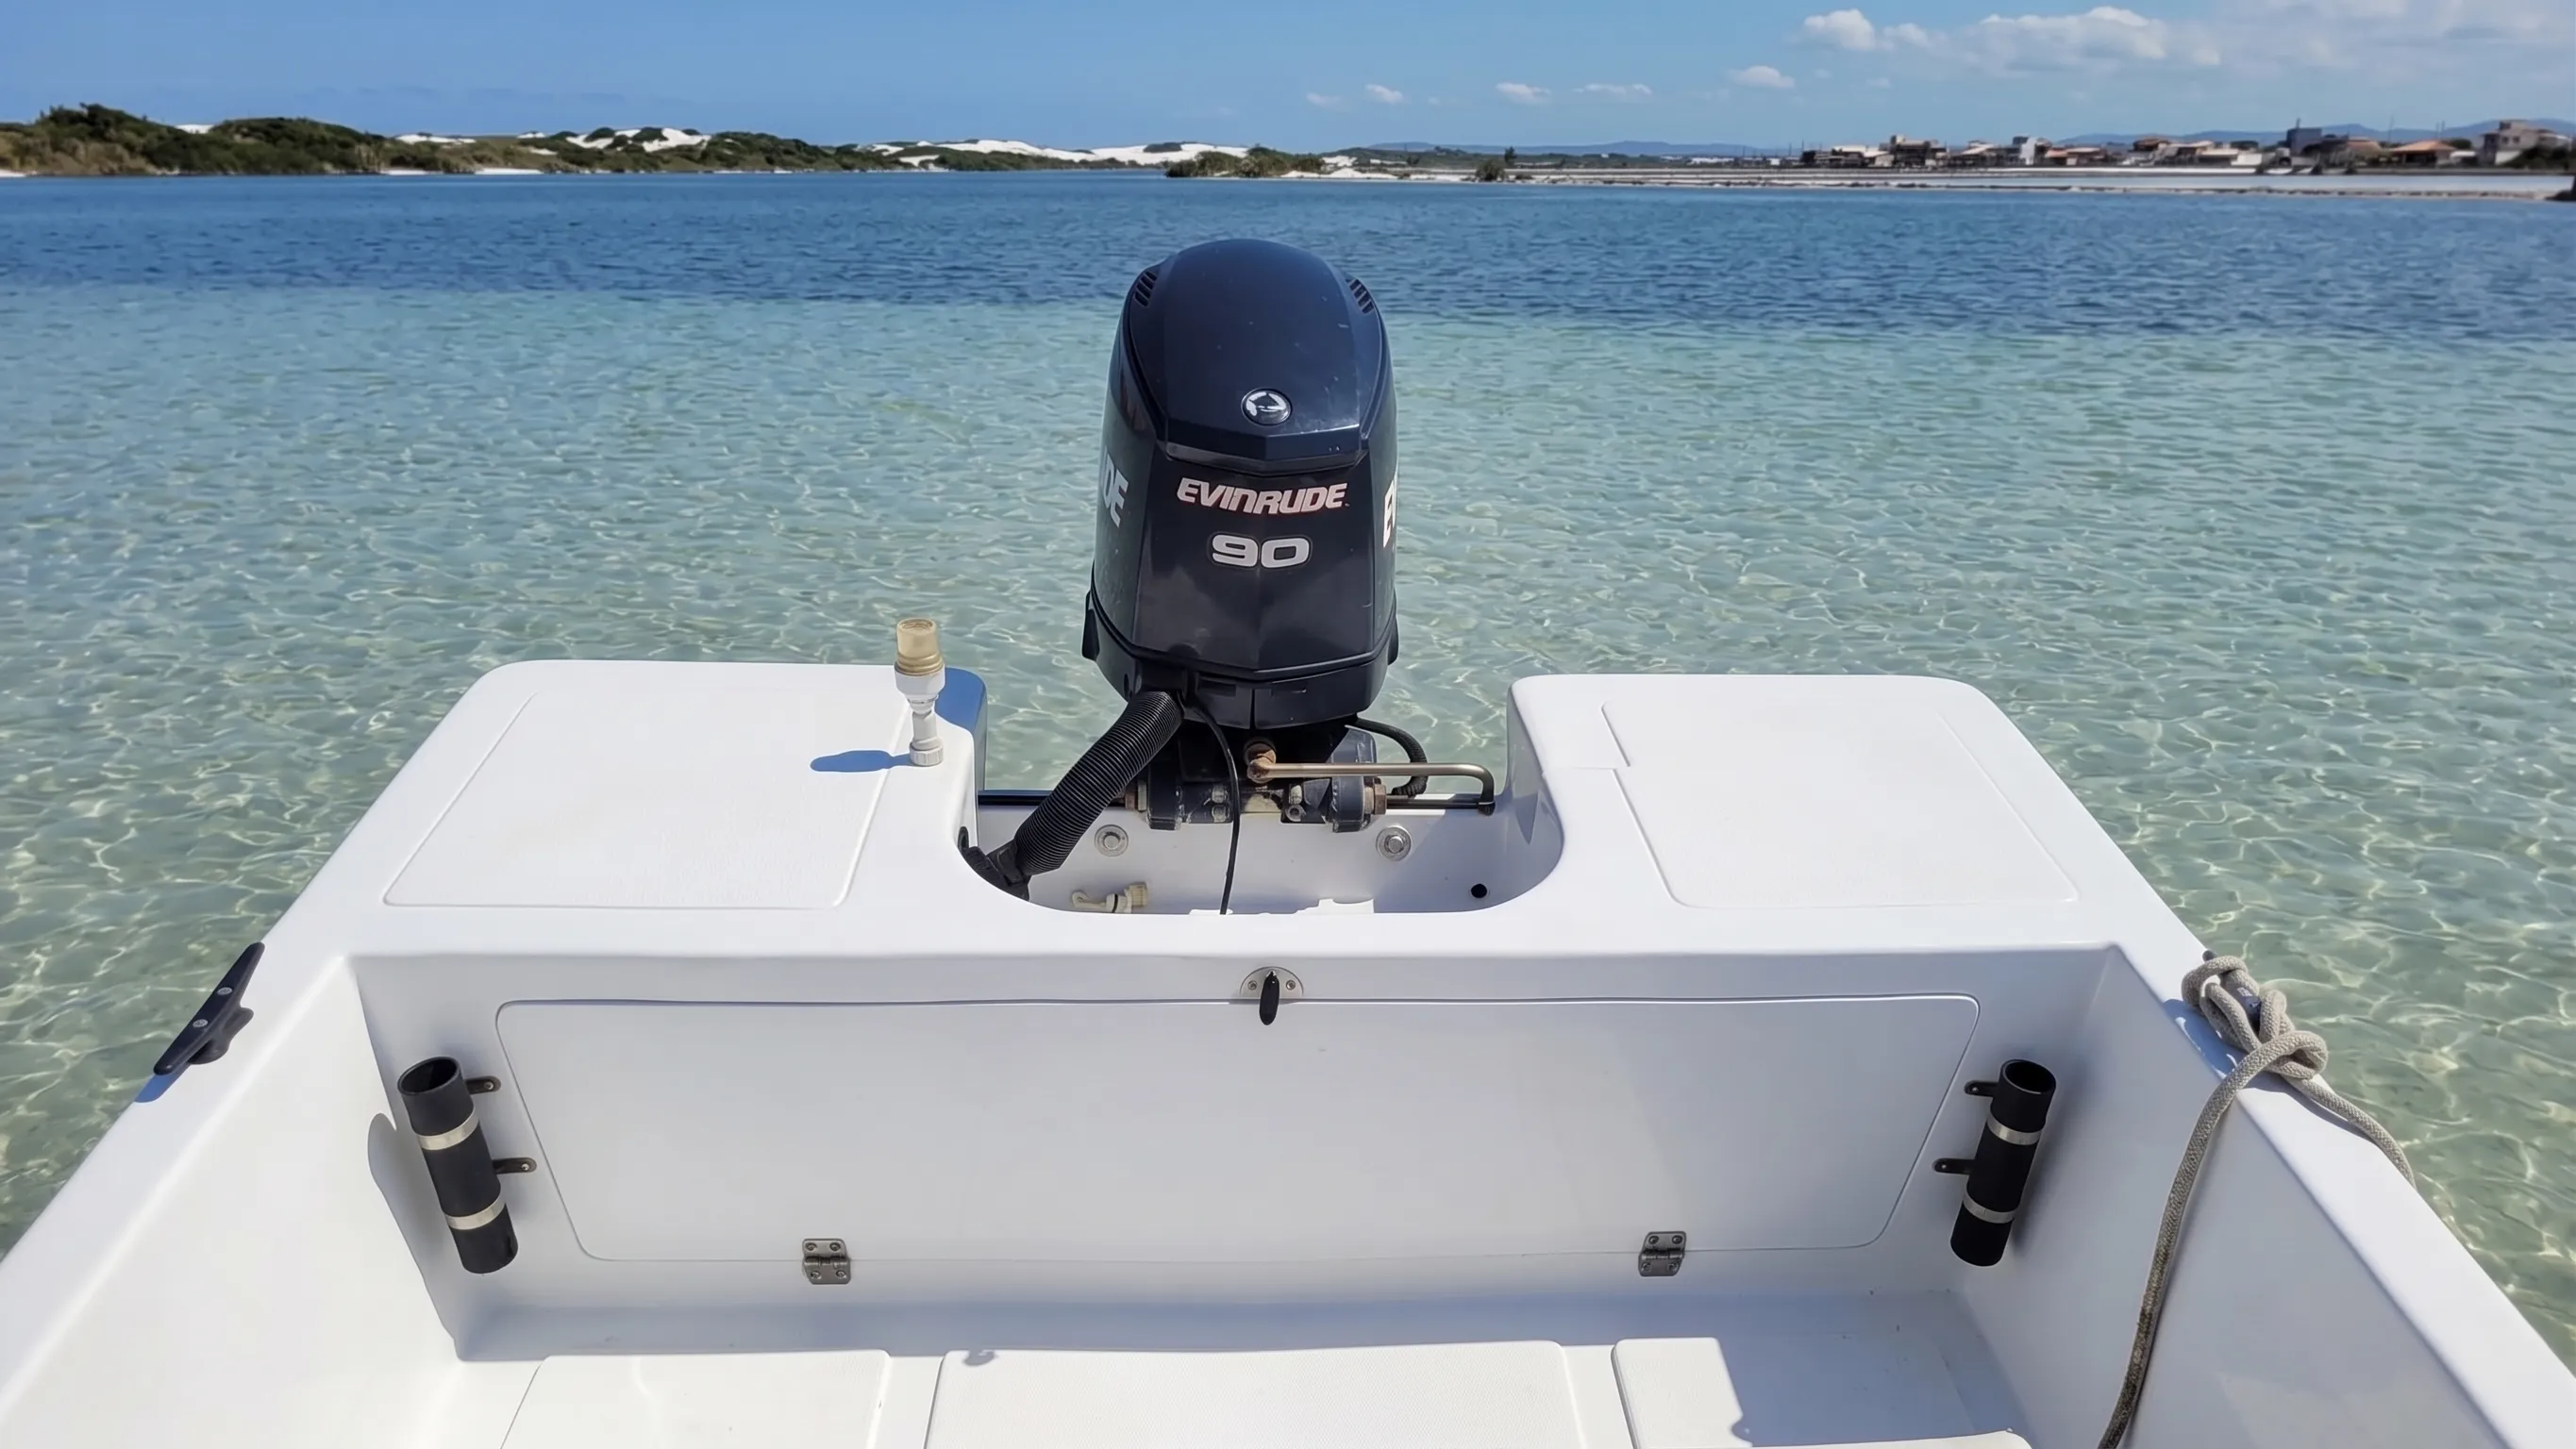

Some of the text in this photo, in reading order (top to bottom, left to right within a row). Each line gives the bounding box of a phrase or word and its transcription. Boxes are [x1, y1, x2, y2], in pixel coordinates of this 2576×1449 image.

[1102, 452, 1129, 528] DE
[1177, 477, 1348, 515] EVINRUDE
[1212, 534, 1311, 569] 90
